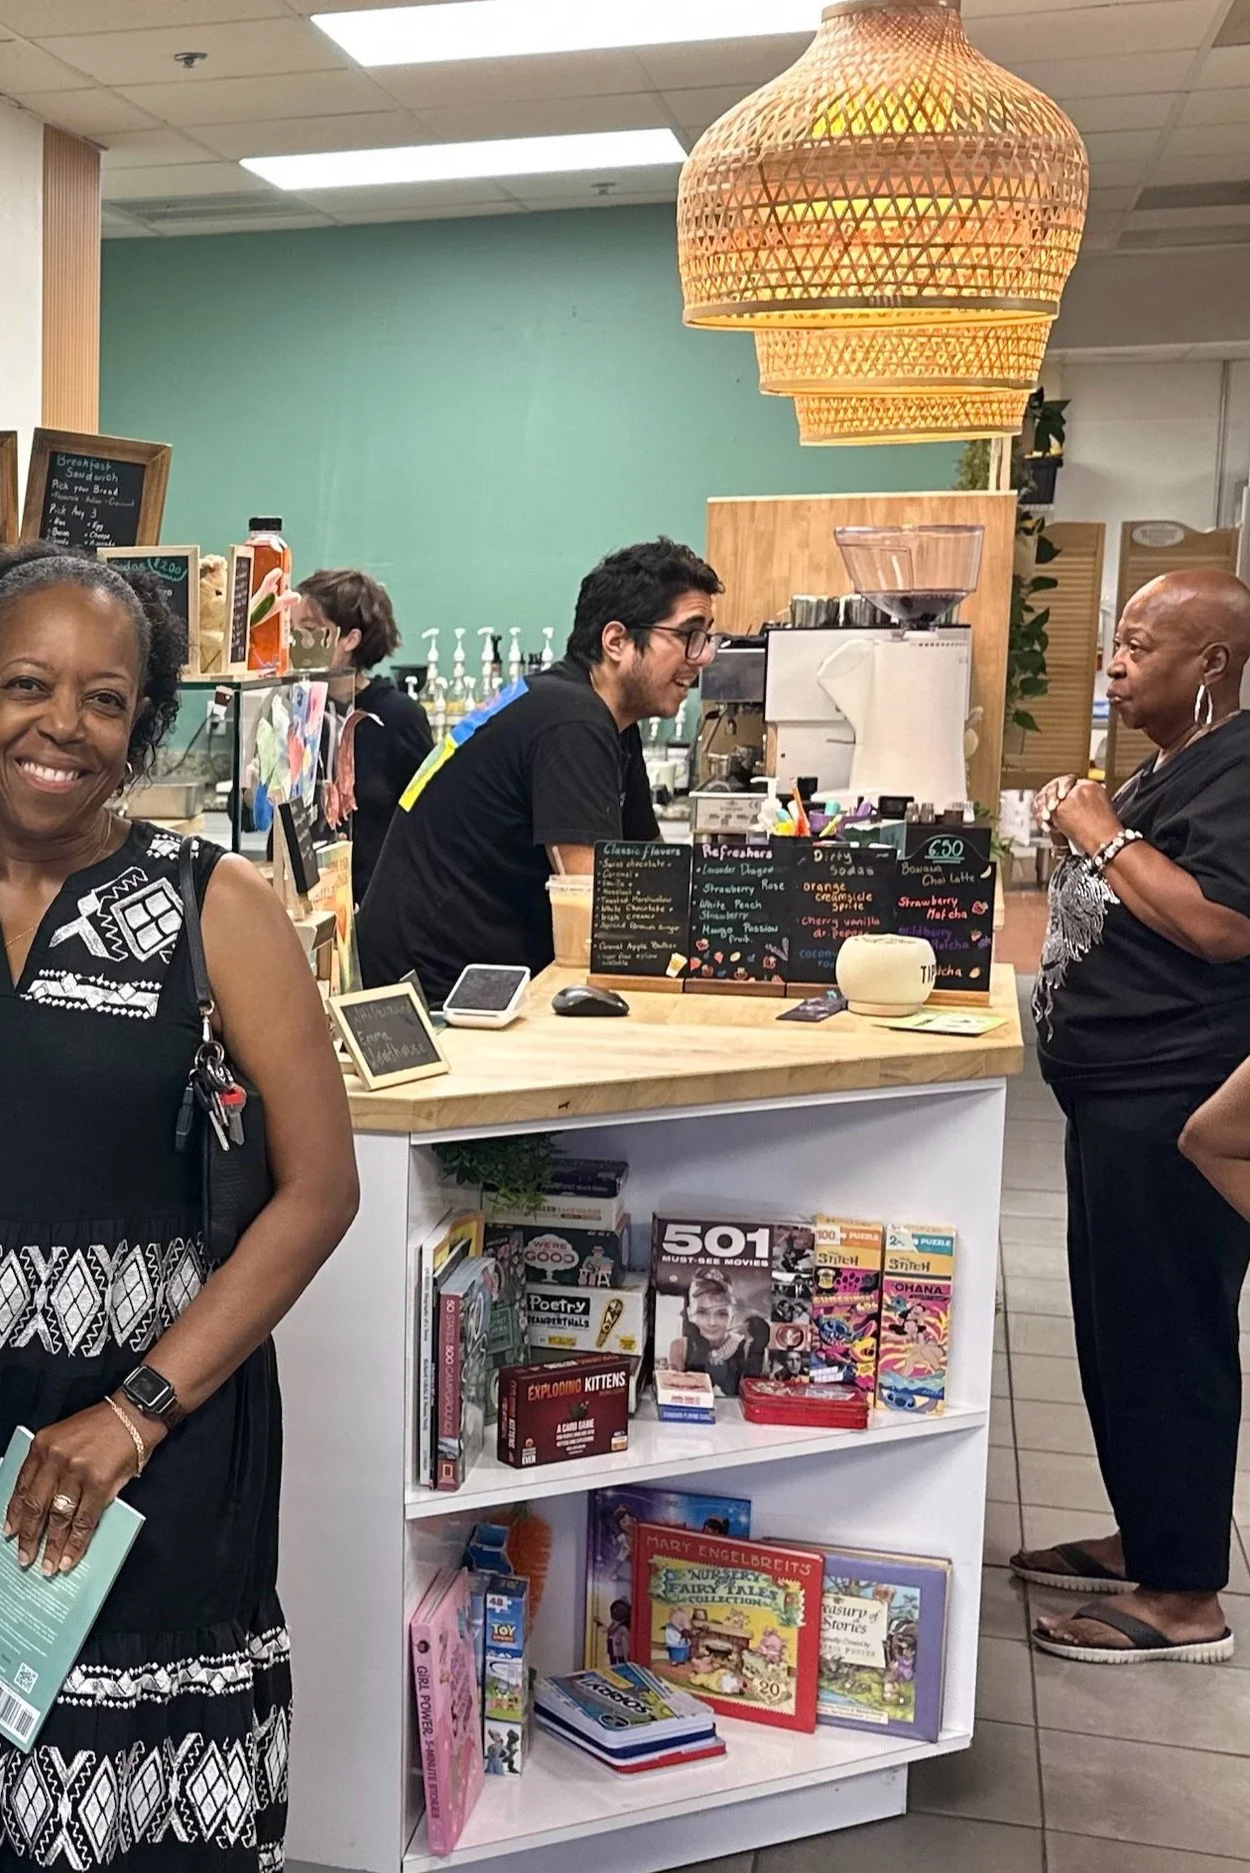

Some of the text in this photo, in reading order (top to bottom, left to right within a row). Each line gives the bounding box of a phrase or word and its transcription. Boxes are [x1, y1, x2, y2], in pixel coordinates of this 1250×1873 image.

[56, 454, 112, 471] Breakfast
[66, 467, 118, 483] Sandwich
[52, 479, 69, 491] Pick
[92, 484, 119, 496] Bread
[49, 503, 66, 515] Pick
[90, 508, 97, 518] 3
[603, 844, 640, 857] Classic
[702, 844, 773, 861] Refreshers
[813, 849, 853, 865] Dirty
[702, 878, 785, 897] Strawberry Rose
[699, 899, 762, 910] White Peach
[898, 895, 958, 907] Strawberry
[699, 910, 750, 921] Strawberry
[926, 908, 968, 920] Matcha
[702, 922, 779, 940] Mango Passion
[799, 949, 835, 960] cocon
[662, 1224, 770, 1259] 501
[817, 1230, 879, 1241] 100 PUZZLE
[921, 1239, 951, 1247] PUZZLE
[525, 1250, 576, 1264] GOOD
[661, 1255, 769, 1268] MUST-SEE MOVIES
[894, 1282, 944, 1295] OHANA
[445, 1299, 455, 1312] 50
[529, 1295, 587, 1314] Poetry
[445, 1345, 455, 1365] 500
[527, 1371, 627, 1401] EXPLODING KITTENS
[556, 1424, 562, 1434] A
[646, 1536, 812, 1576] MARY ENGELBREIT'S
[688, 1568, 762, 1582] NURSERY
[666, 1583, 779, 1599] FAIRY TALES
[489, 1597, 504, 1608] 48
[688, 1596, 762, 1607] COLLECTION
[822, 1603, 881, 1622] easury of
[492, 1623, 517, 1637] TOY
[822, 1615, 867, 1634] Stories
[759, 1681, 780, 1696] 20
[417, 1666, 429, 1692] GIRL
[425, 1740, 438, 1783] 5-MINUTE
